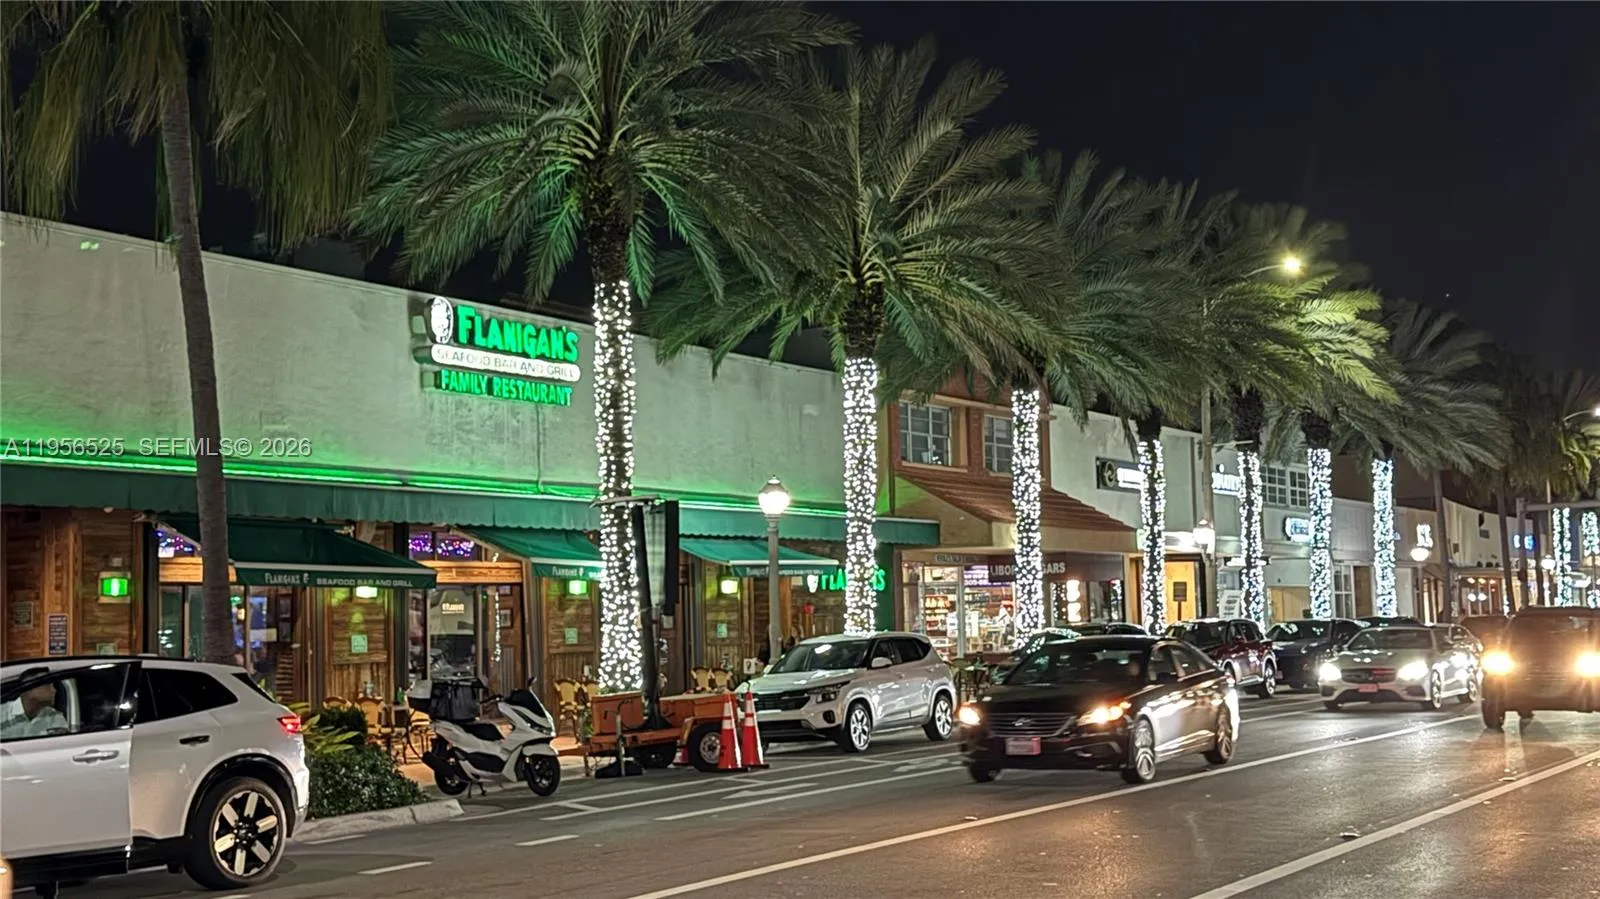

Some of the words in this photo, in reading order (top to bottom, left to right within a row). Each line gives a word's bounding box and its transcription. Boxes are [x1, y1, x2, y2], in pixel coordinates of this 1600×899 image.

[457, 304, 579, 361] FLANIGAN'S
[437, 348, 491, 367] SEAFOOD
[494, 356, 517, 369] BAR
[520, 360, 545, 374] AND
[546, 363, 575, 378] GRILL
[441, 368, 488, 396] FAMILY
[493, 376, 573, 406] RESTAURANT
[316, 577, 355, 586] SEAFOOD
[375, 579, 392, 587] AND
